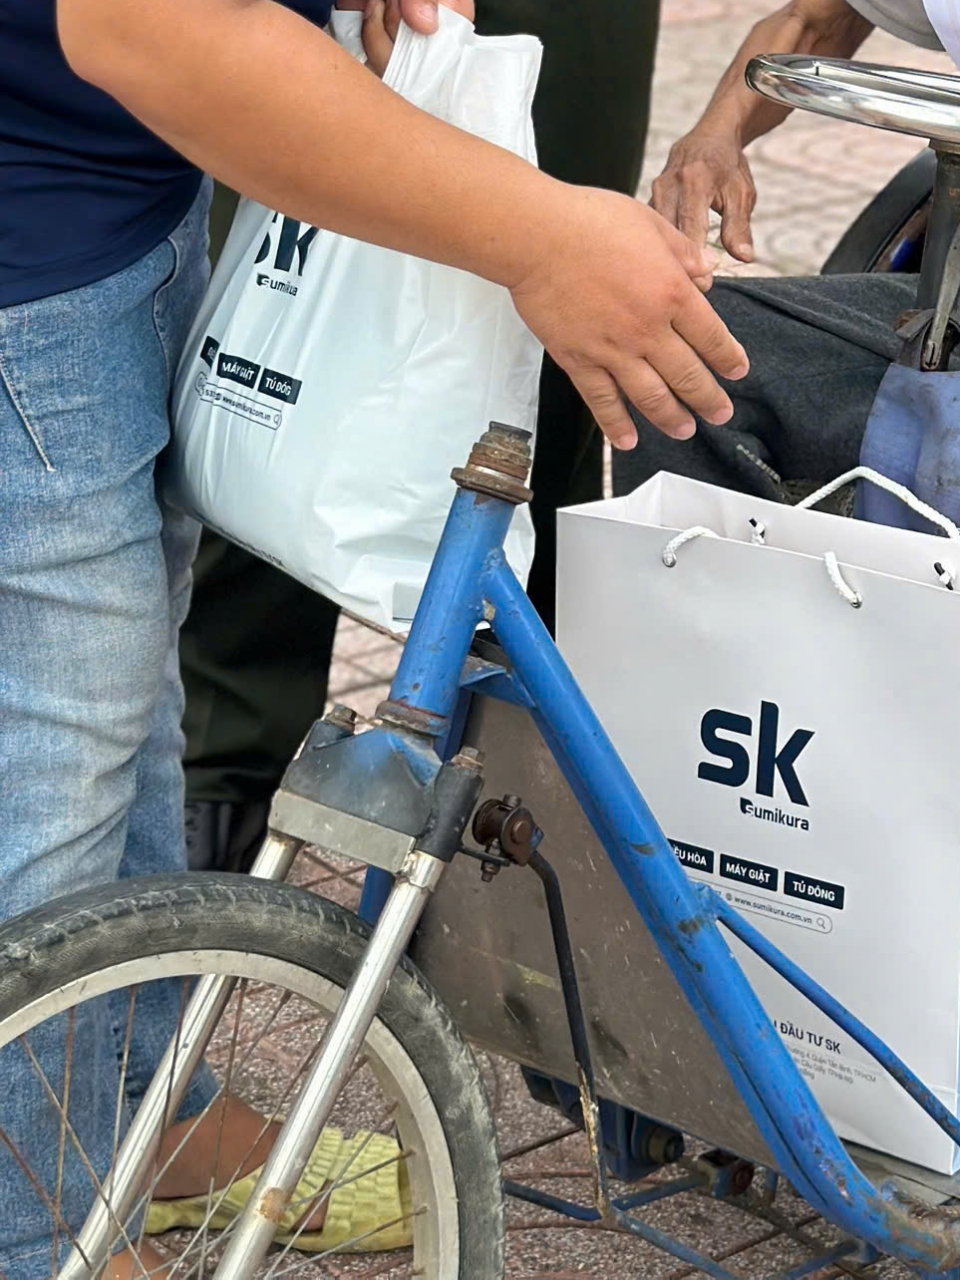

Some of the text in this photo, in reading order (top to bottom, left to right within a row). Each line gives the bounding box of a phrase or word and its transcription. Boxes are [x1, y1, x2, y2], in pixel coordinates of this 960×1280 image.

[687, 848, 707, 866] HÒA
[726, 862, 771, 884] MÁY GIẶT
[792, 880, 835, 902] TỦ ĐÔNG
[780, 1020, 804, 1040] ĐẦU
[806, 1031, 823, 1047] TƯ
[825, 1038, 841, 1054] SK
